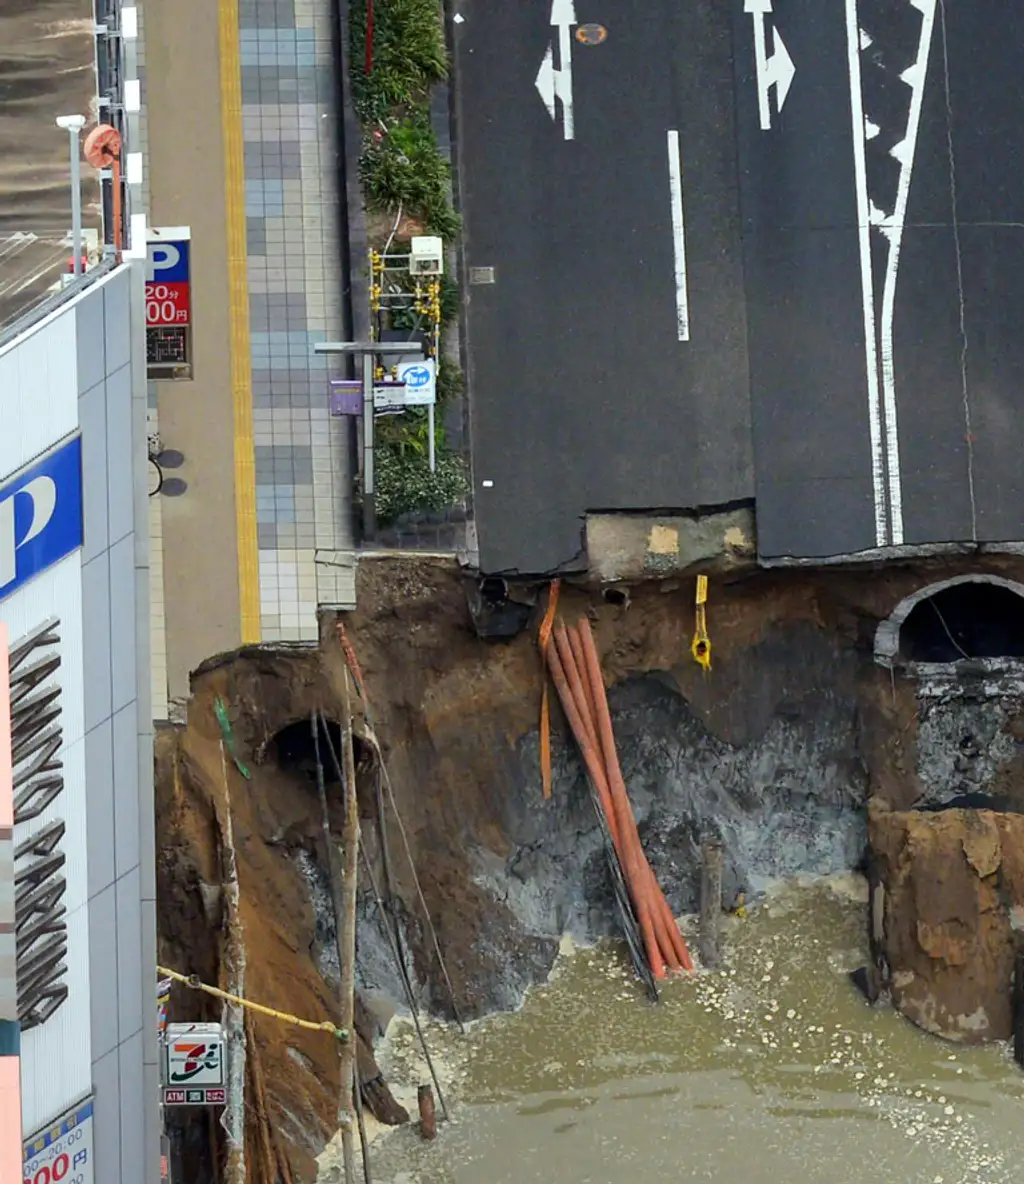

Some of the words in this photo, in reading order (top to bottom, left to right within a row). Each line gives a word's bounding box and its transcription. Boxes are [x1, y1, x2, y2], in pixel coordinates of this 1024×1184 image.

[146, 243, 180, 281] P
[0, 475, 56, 589] P
[167, 1092, 184, 1101] ATM
